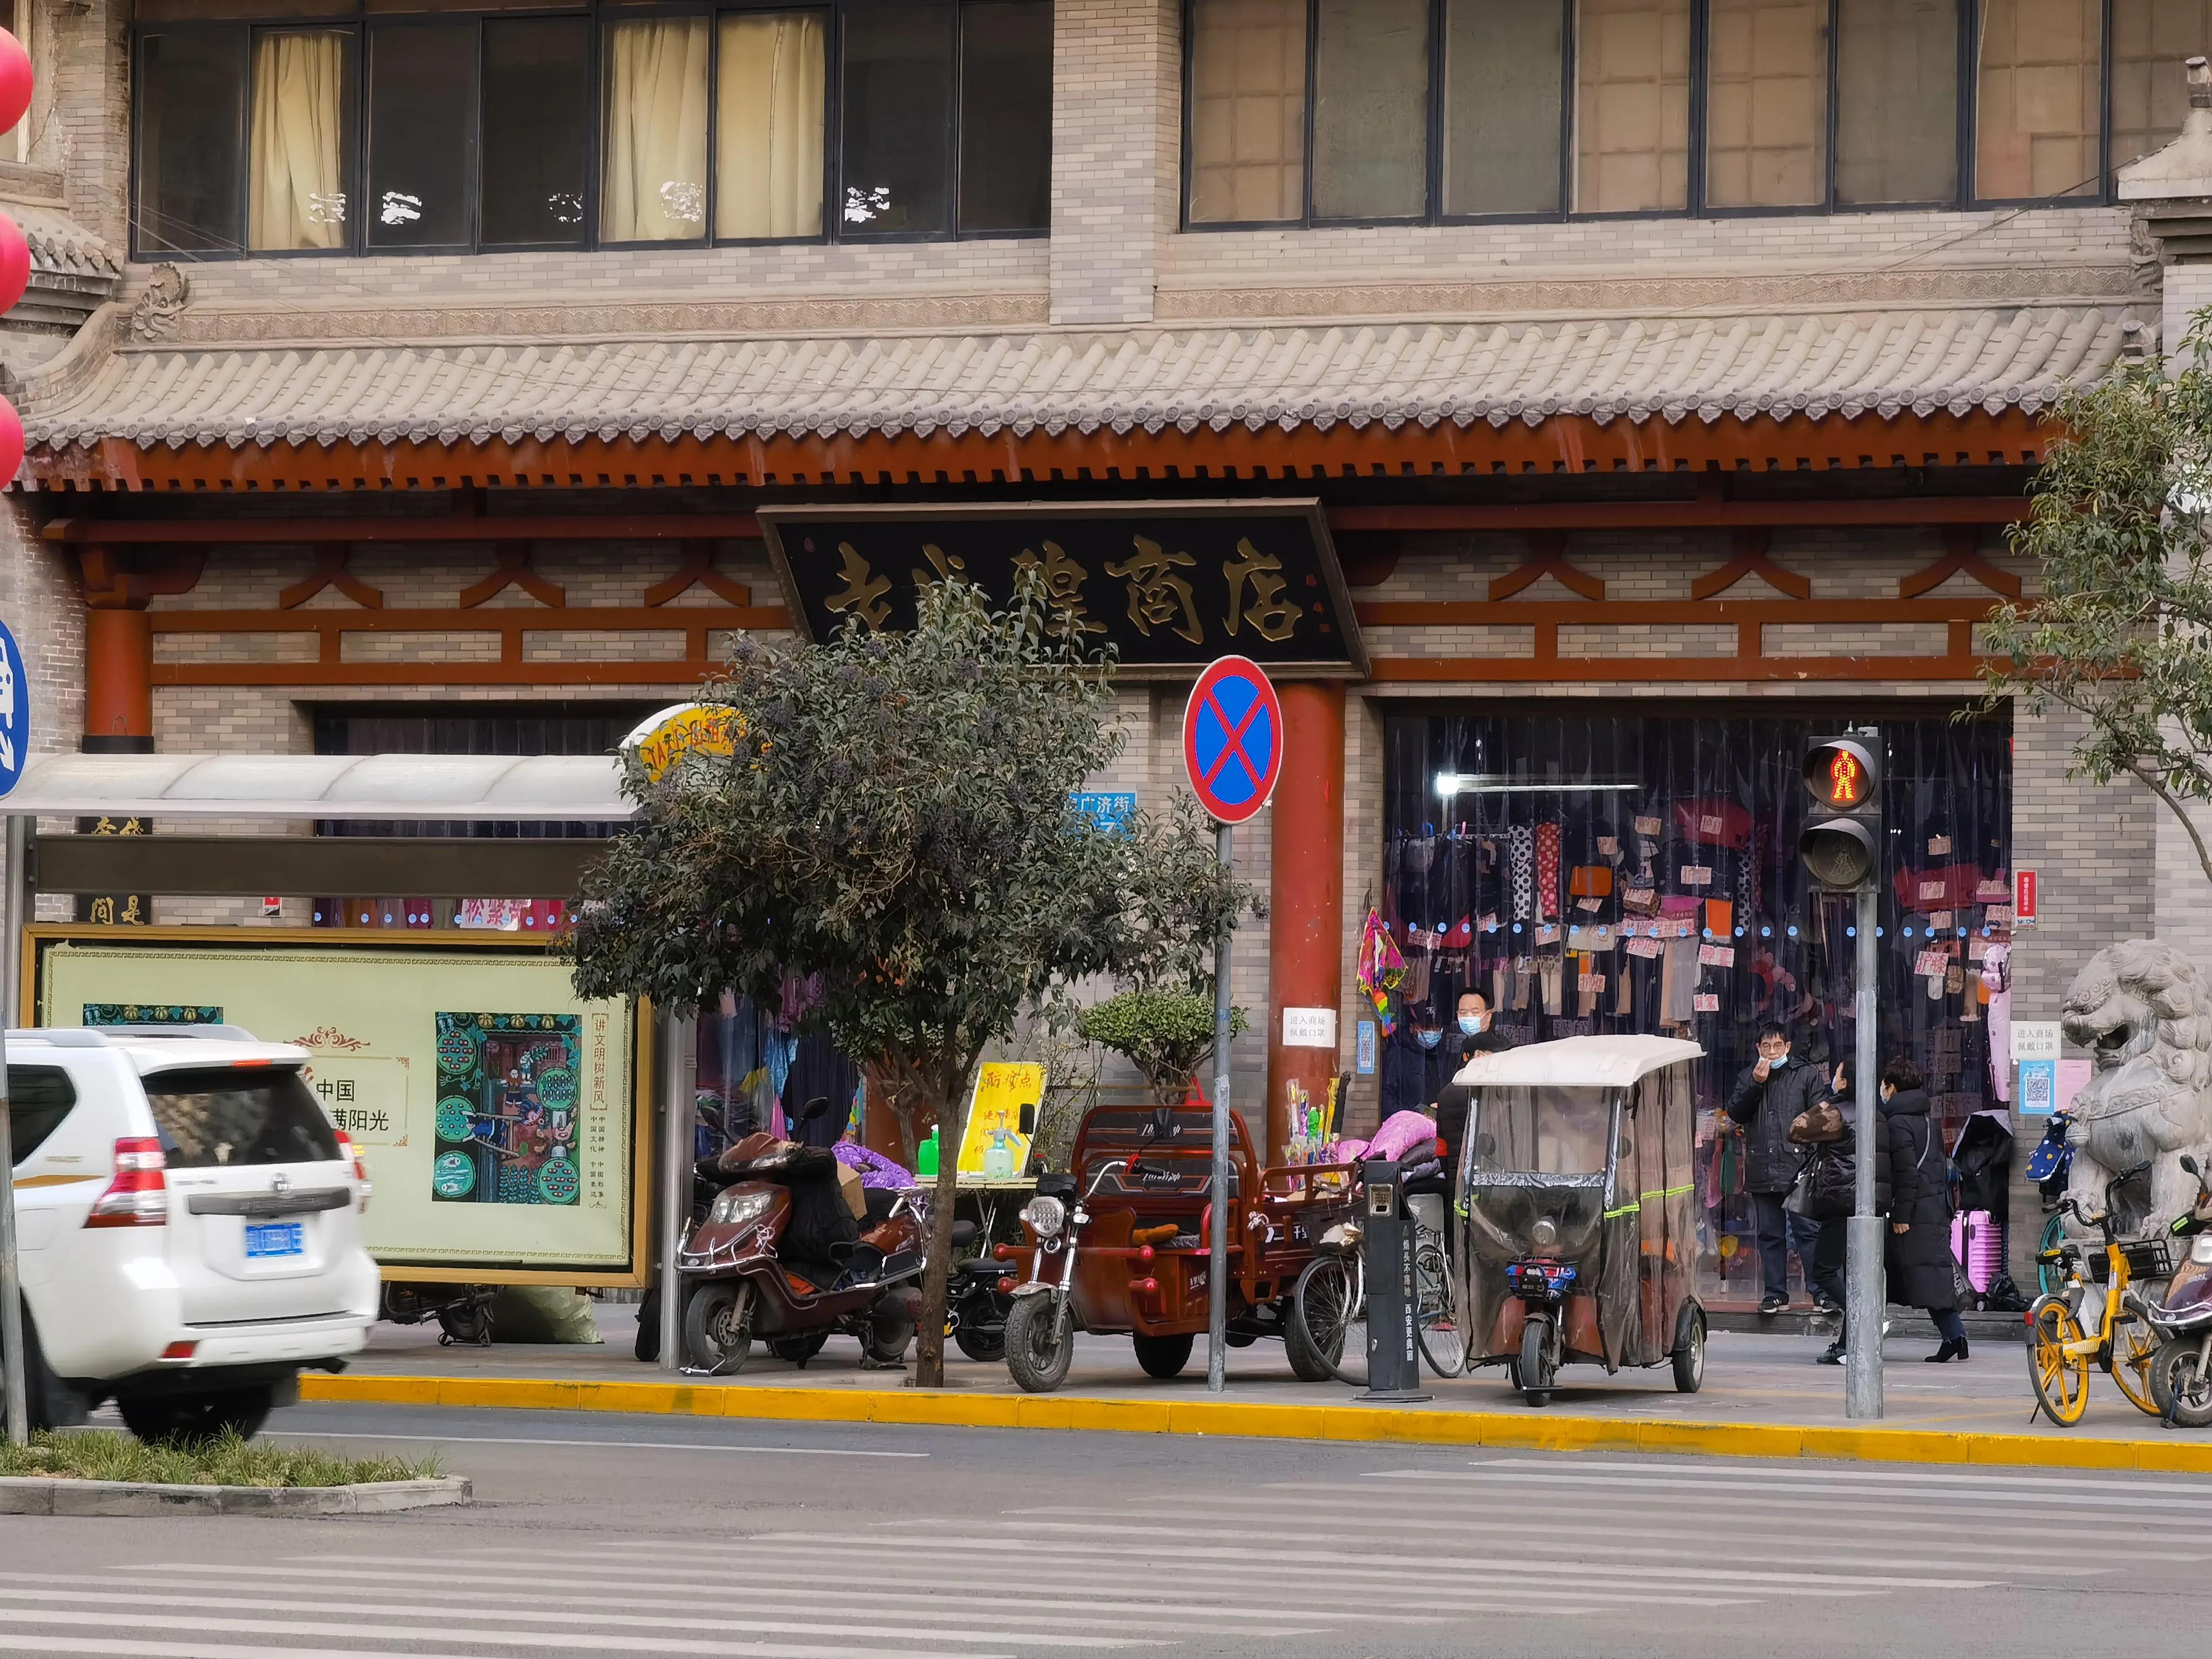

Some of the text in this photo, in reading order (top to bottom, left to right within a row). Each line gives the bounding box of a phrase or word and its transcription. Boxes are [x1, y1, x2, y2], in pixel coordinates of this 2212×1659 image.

[1290, 1015, 1326, 1026] 进入商场
[1290, 1028, 1325, 1037] 佩戴口罩
[2017, 1028, 2054, 1039] 进入商场
[2017, 1042, 2054, 1052] 佩戴口罩
[593, 1019, 606, 1104] 讲文明树新风
[316, 1078, 355, 1102] 中国
